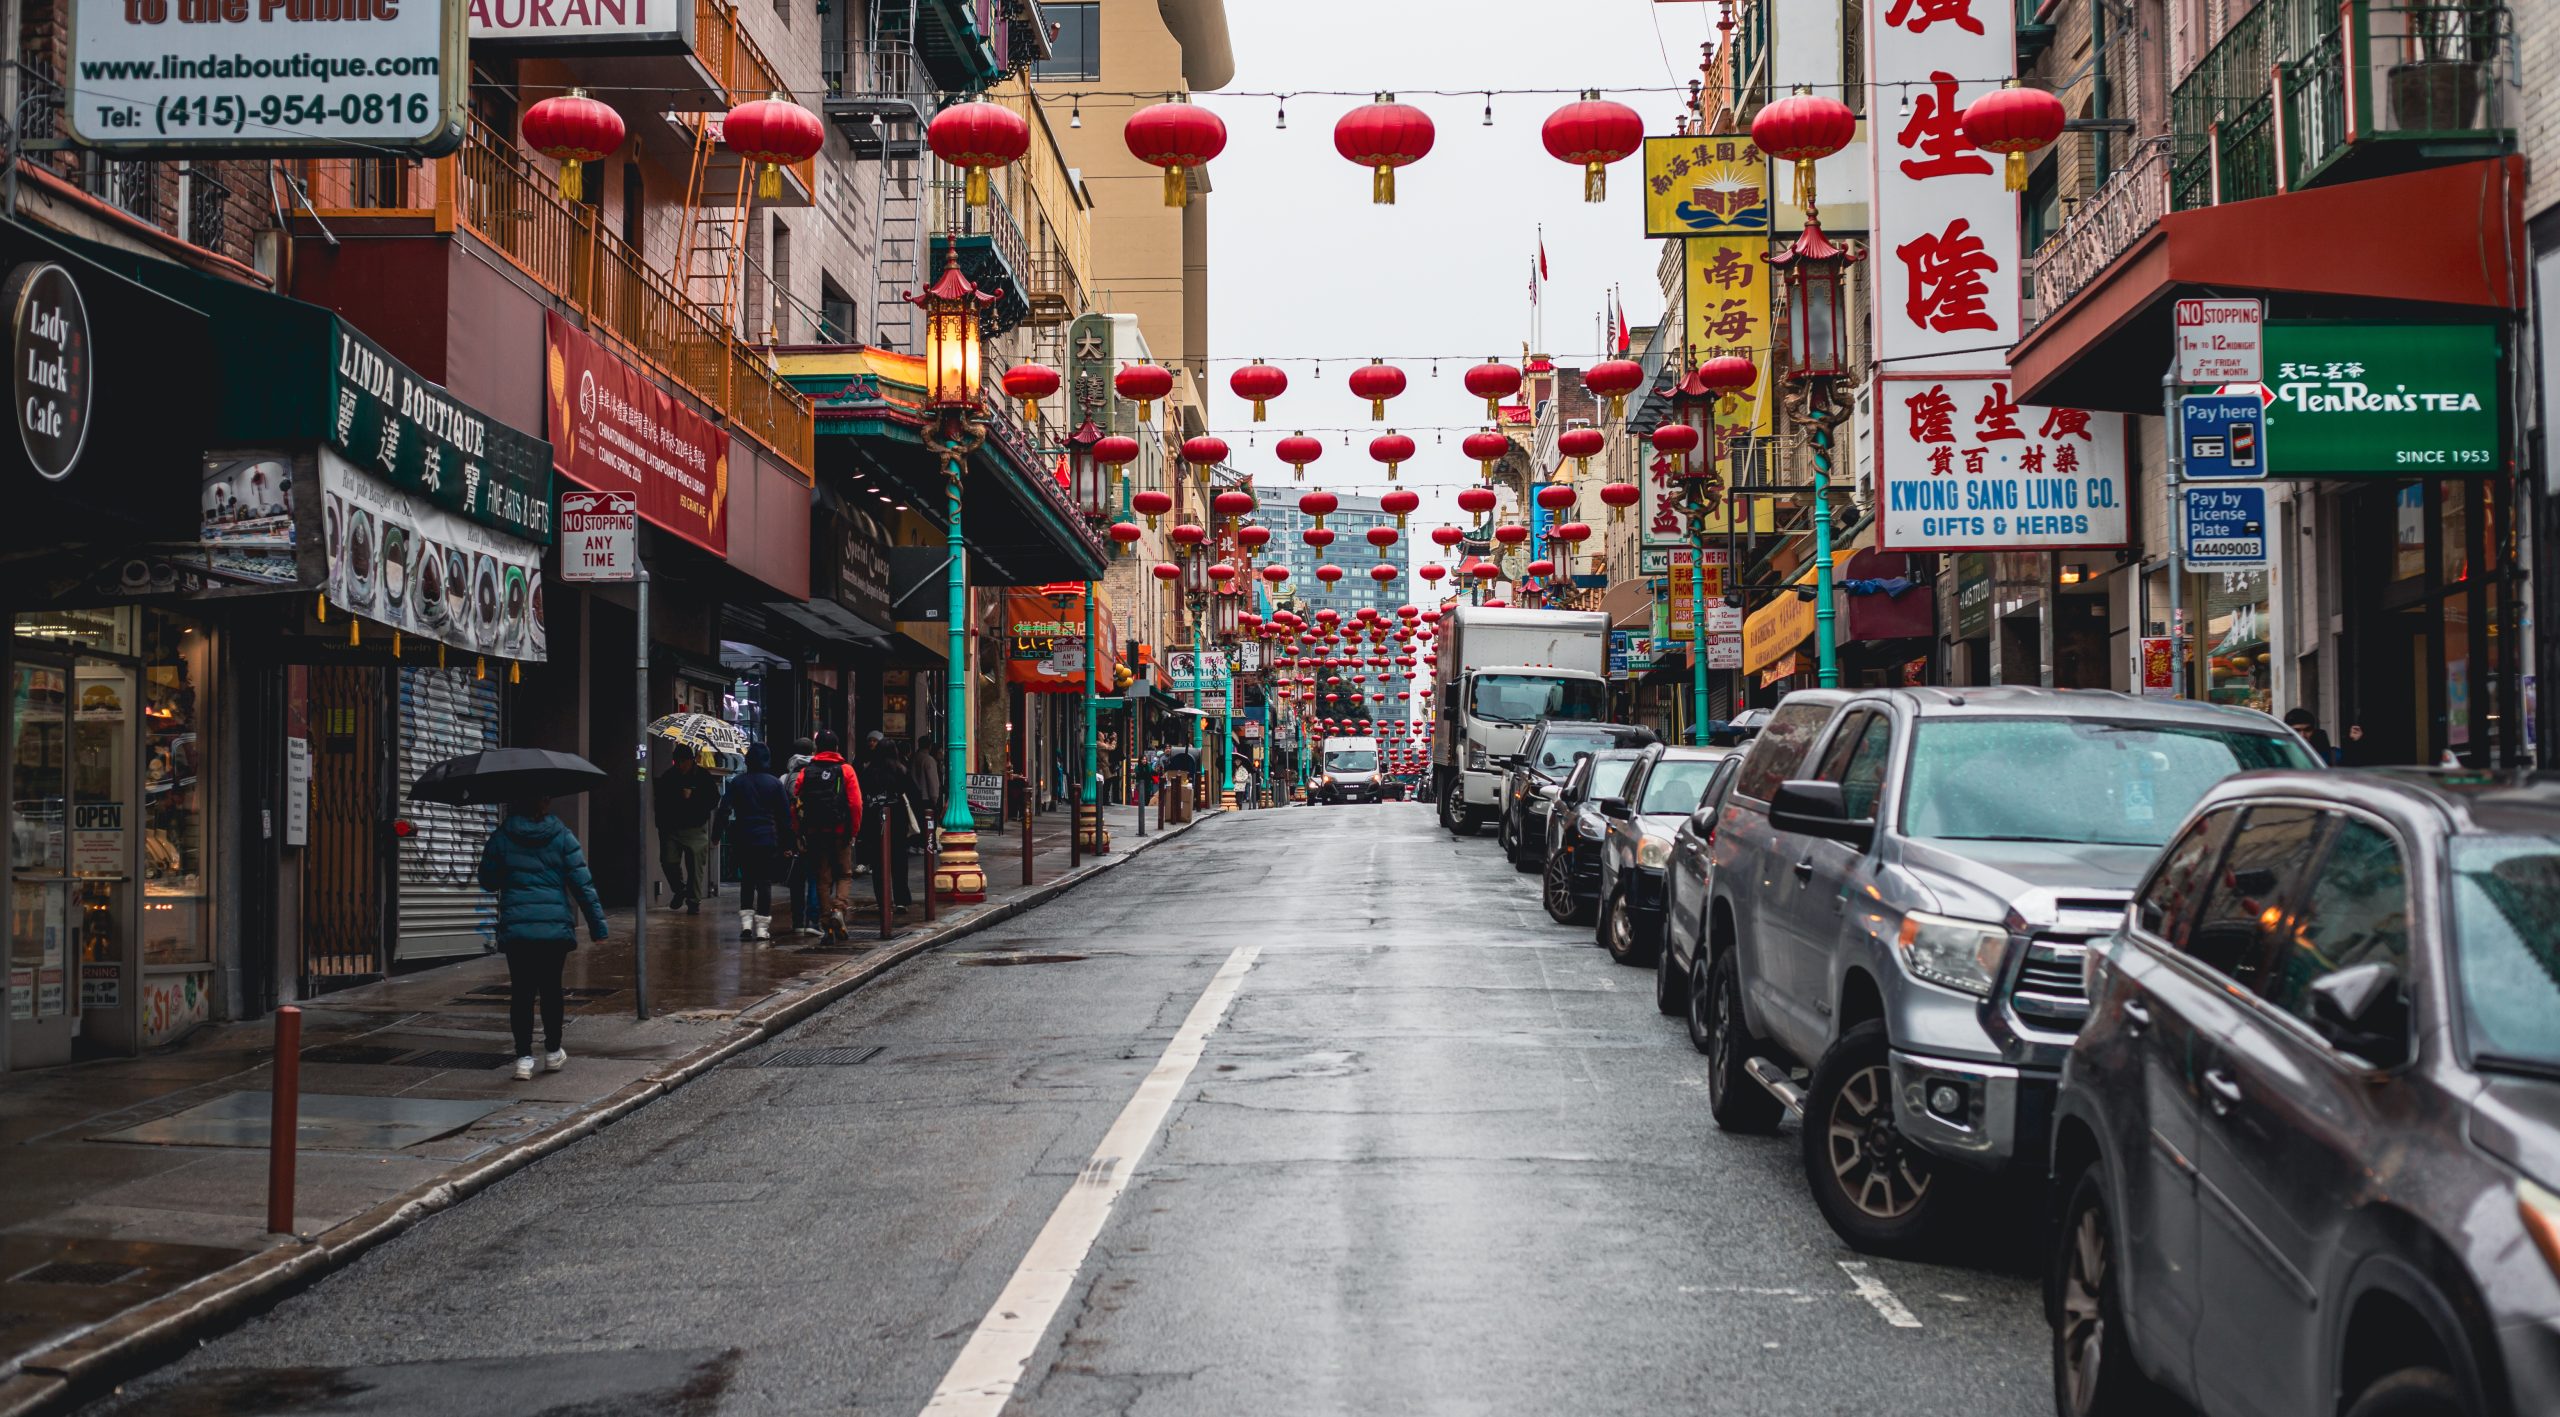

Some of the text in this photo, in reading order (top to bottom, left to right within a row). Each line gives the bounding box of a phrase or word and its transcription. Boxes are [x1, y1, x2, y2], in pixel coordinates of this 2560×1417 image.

[80, 54, 439, 83] www.lindaboutique.com
[97, 93, 428, 134] Tel: (415)-954-0816
[2181, 304, 2258, 323] NO STOPPING
[30, 301, 69, 351] Lady
[28, 348, 68, 392] Luck
[2278, 362, 2366, 379] 天仁茗茶
[339, 333, 484, 458] LINDA BOUTIQUE
[2419, 393, 2482, 411] TEA
[26, 396, 62, 438] Cafe
[2187, 404, 2257, 423] Pay here
[2396, 451, 2490, 463] SINCE 1953
[1891, 477, 2119, 511] KWONG SANG LUNG CO.
[2190, 491, 2242, 509] Pay by
[487, 479, 549, 533] FINE ARTS & GIFTS
[2191, 508, 2247, 521] License
[565, 514, 633, 531] NO STOPPING
[1923, 515, 2088, 536] GIFTS & HERBS
[2192, 523, 2230, 536] Plate
[585, 536, 612, 549] ANY
[2194, 543, 2260, 555] 44409003
[583, 553, 615, 566] TIME
[1705, 552, 1715, 563] WE
[1717, 552, 1728, 563] FIX
[1708, 598, 1718, 608] NO
[1709, 635, 1717, 644] NO
[712, 727, 733, 742] SAN
[972, 776, 998, 787] OPEN
[75, 806, 121, 828] OPEN
